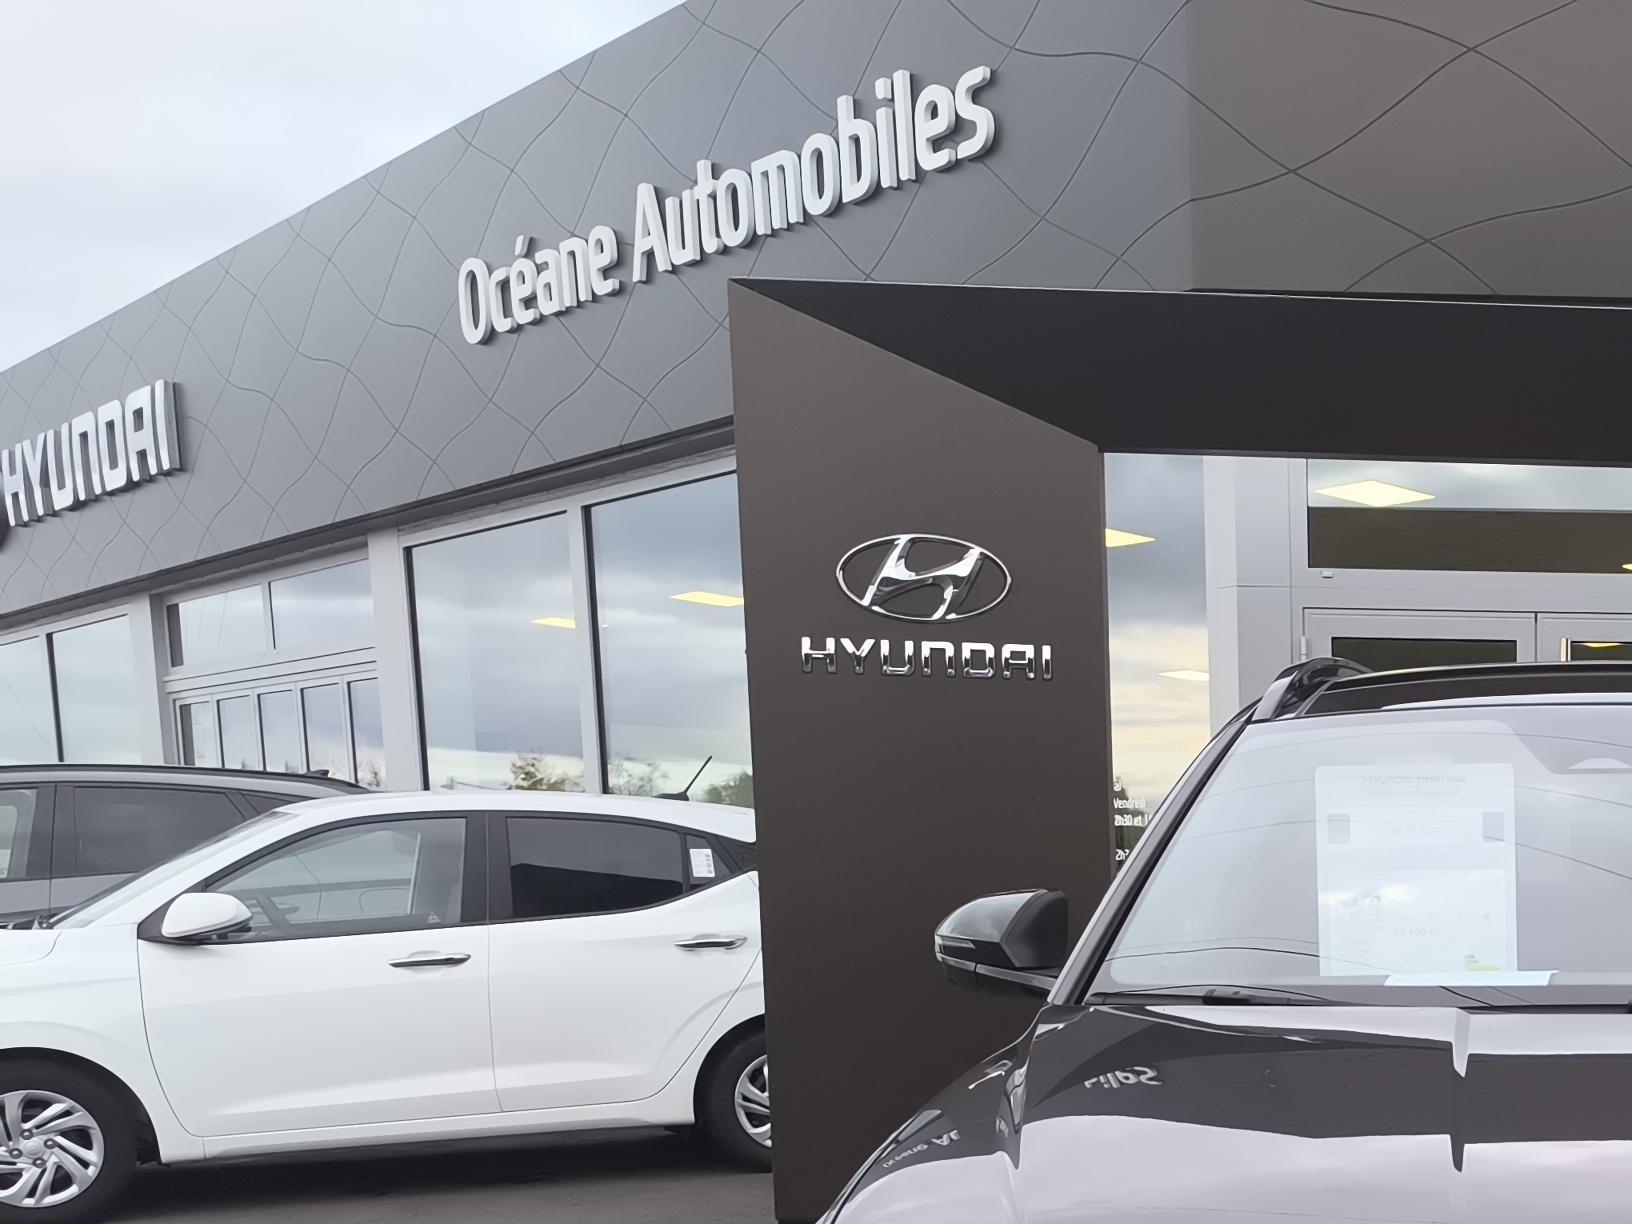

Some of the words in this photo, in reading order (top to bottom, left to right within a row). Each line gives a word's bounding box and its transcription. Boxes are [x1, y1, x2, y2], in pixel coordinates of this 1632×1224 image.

[457, 224, 619, 346] Océane
[631, 65, 996, 284] Automobiles
[2, 379, 183, 528] HYUNDAI
[799, 636, 1054, 683] HYUNDAI
